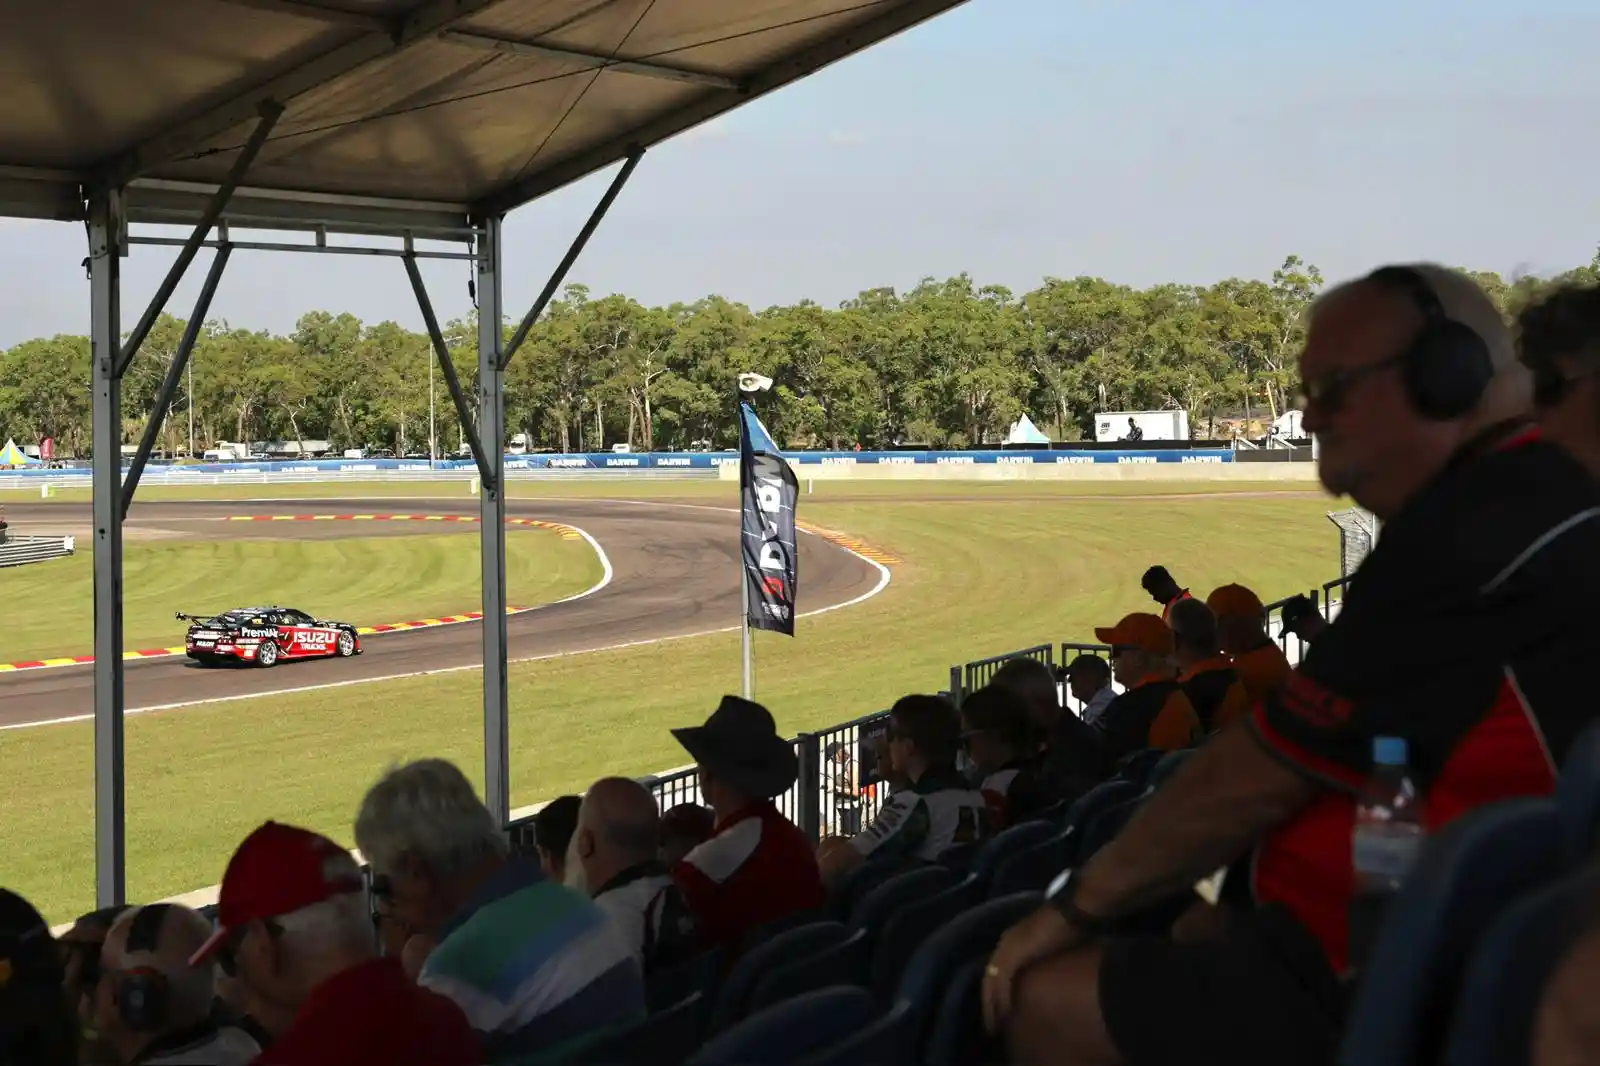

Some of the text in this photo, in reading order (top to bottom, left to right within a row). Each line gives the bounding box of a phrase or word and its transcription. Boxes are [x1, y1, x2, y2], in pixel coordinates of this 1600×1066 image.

[657, 458, 691, 466] DARWIN
[996, 456, 1034, 465] DARWIN
[1056, 456, 1095, 465] DARWIN
[1118, 456, 1157, 465] DARWIN
[1181, 455, 1222, 465] DARWIN
[293, 631, 336, 643] ISUZU
